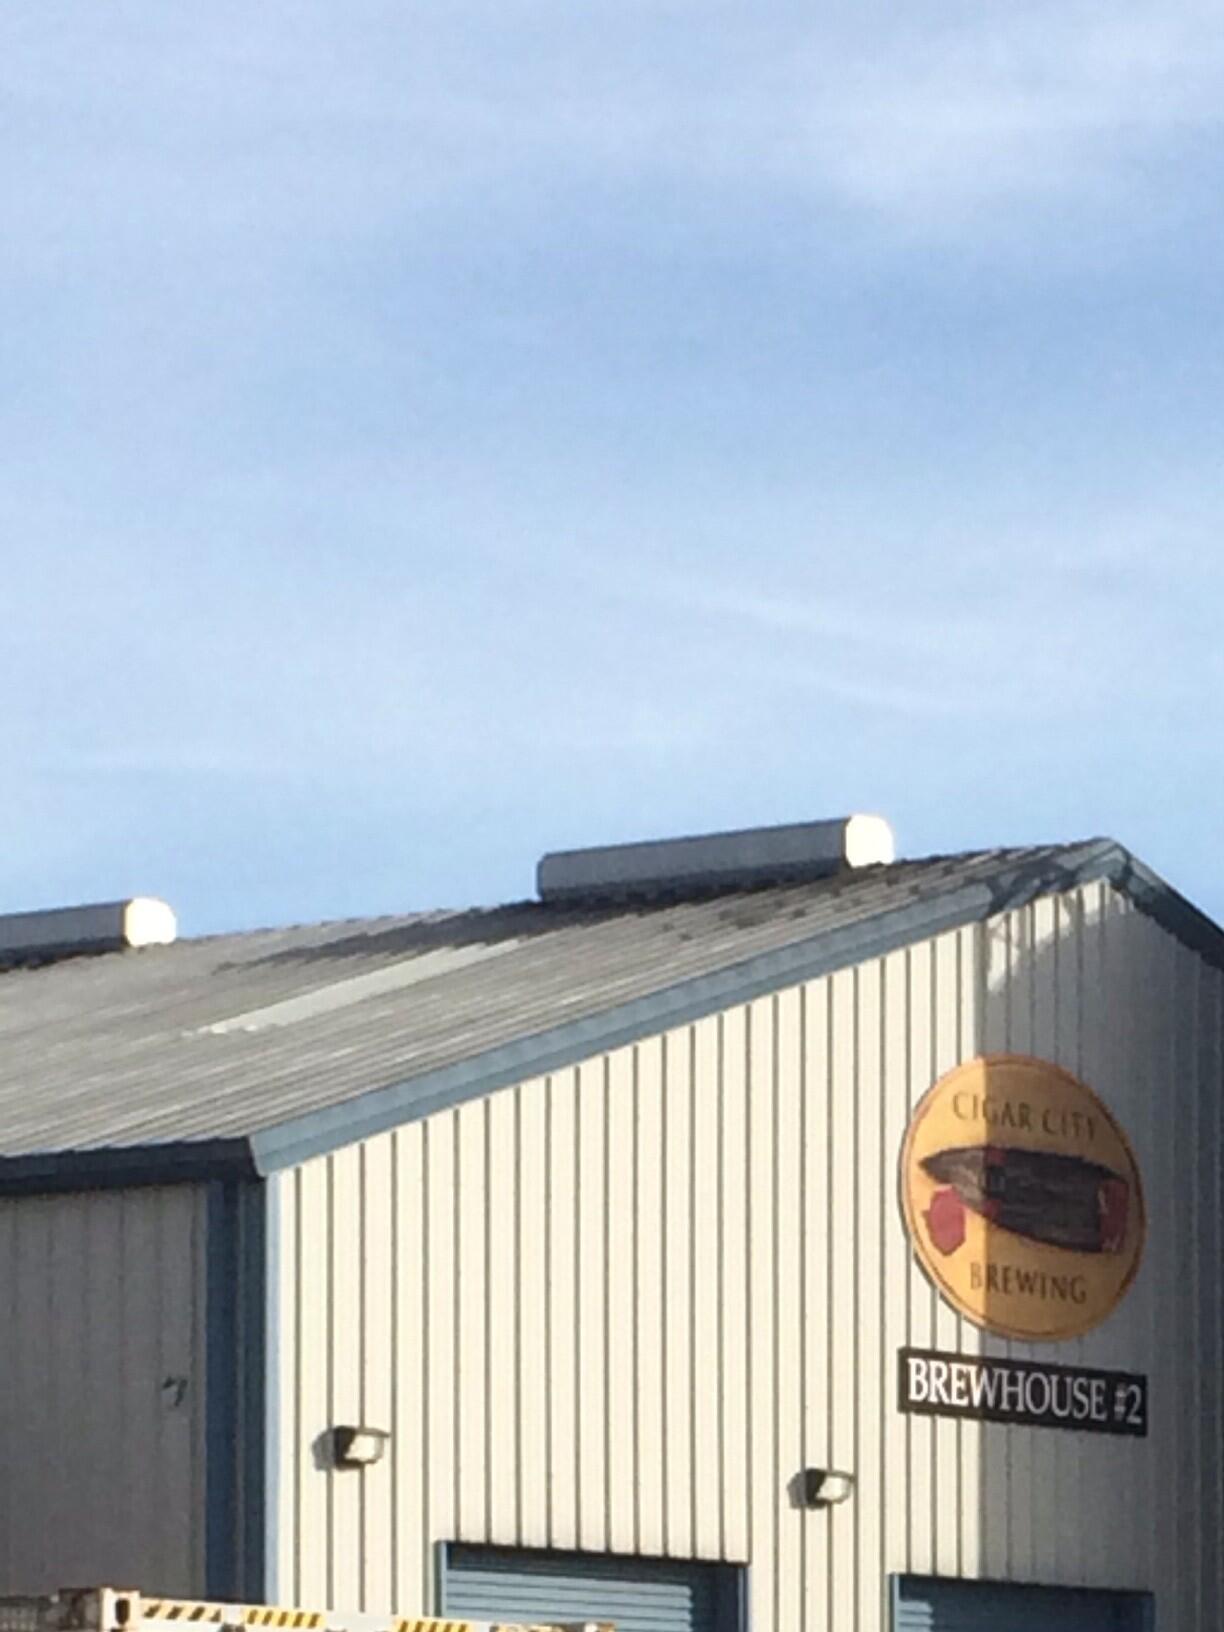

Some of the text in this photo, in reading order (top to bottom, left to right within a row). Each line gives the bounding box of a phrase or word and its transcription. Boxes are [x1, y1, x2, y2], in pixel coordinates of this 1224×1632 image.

[953, 1091, 1095, 1141] CIGAR CITY
[970, 1261, 1087, 1304] BREWING
[907, 1356, 1144, 1425] BREWHOUSE #2
